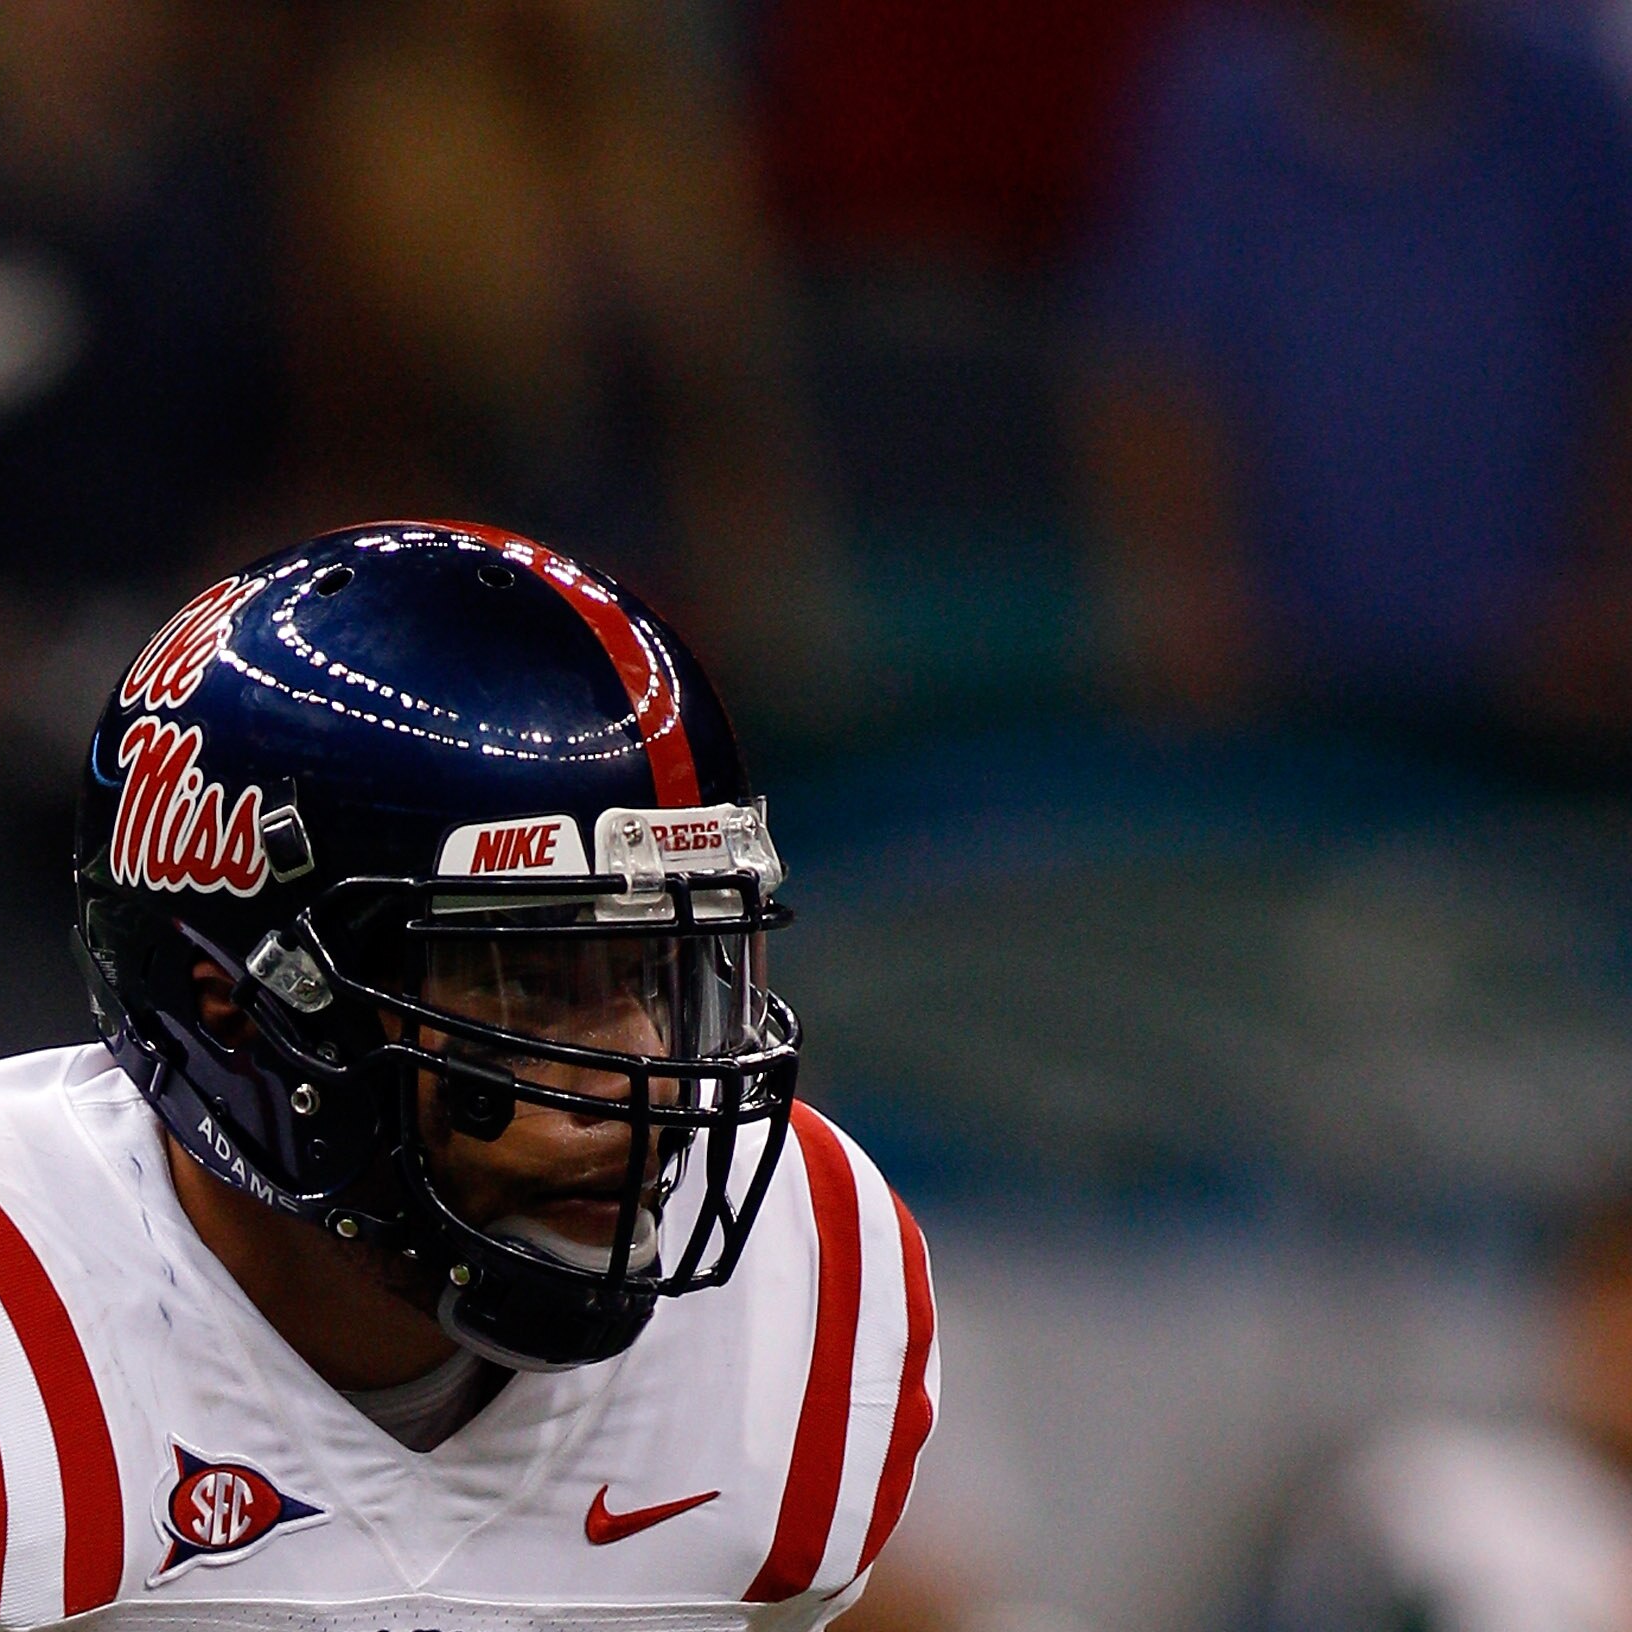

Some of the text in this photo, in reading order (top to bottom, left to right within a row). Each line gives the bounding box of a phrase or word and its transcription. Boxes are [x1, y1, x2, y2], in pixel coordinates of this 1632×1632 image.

[120, 576, 266, 711] Ole
[110, 716, 269, 898] Miss
[470, 823, 561, 874] NIKE
[190, 1472, 254, 1545] SEC
